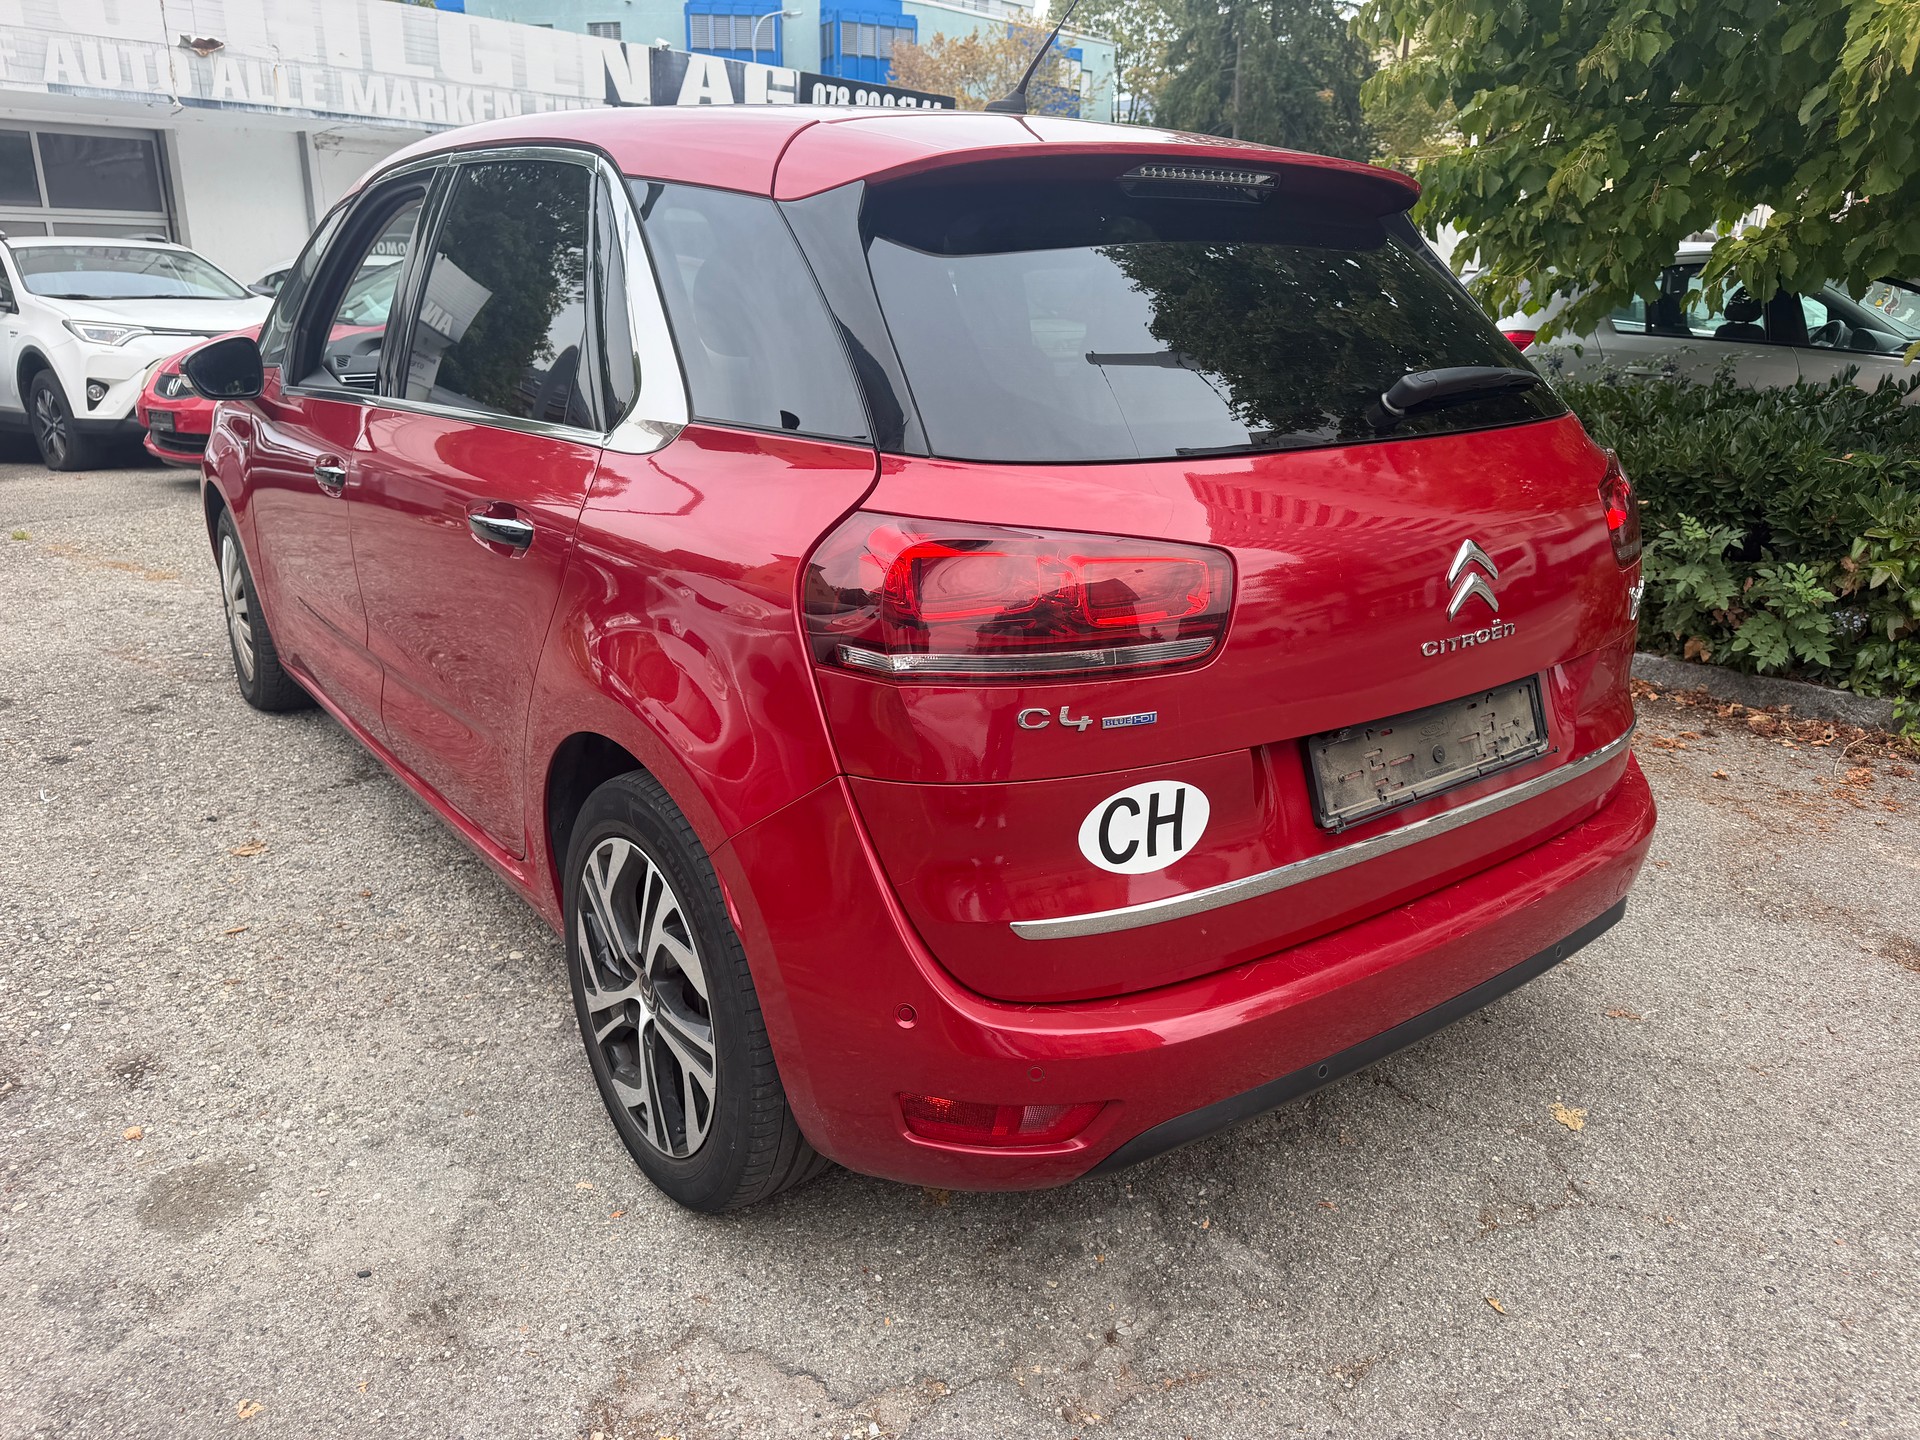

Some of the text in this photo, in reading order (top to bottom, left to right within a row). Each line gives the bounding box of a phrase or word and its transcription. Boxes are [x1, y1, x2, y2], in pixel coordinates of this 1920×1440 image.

[44, 37, 192, 95] AUTO
[211, 56, 328, 109] ALLE
[341, 71, 522, 125] MARKEN
[676, 53, 796, 105] AG
[812, 82, 850, 105] 078
[1098, 787, 1186, 865] CH
